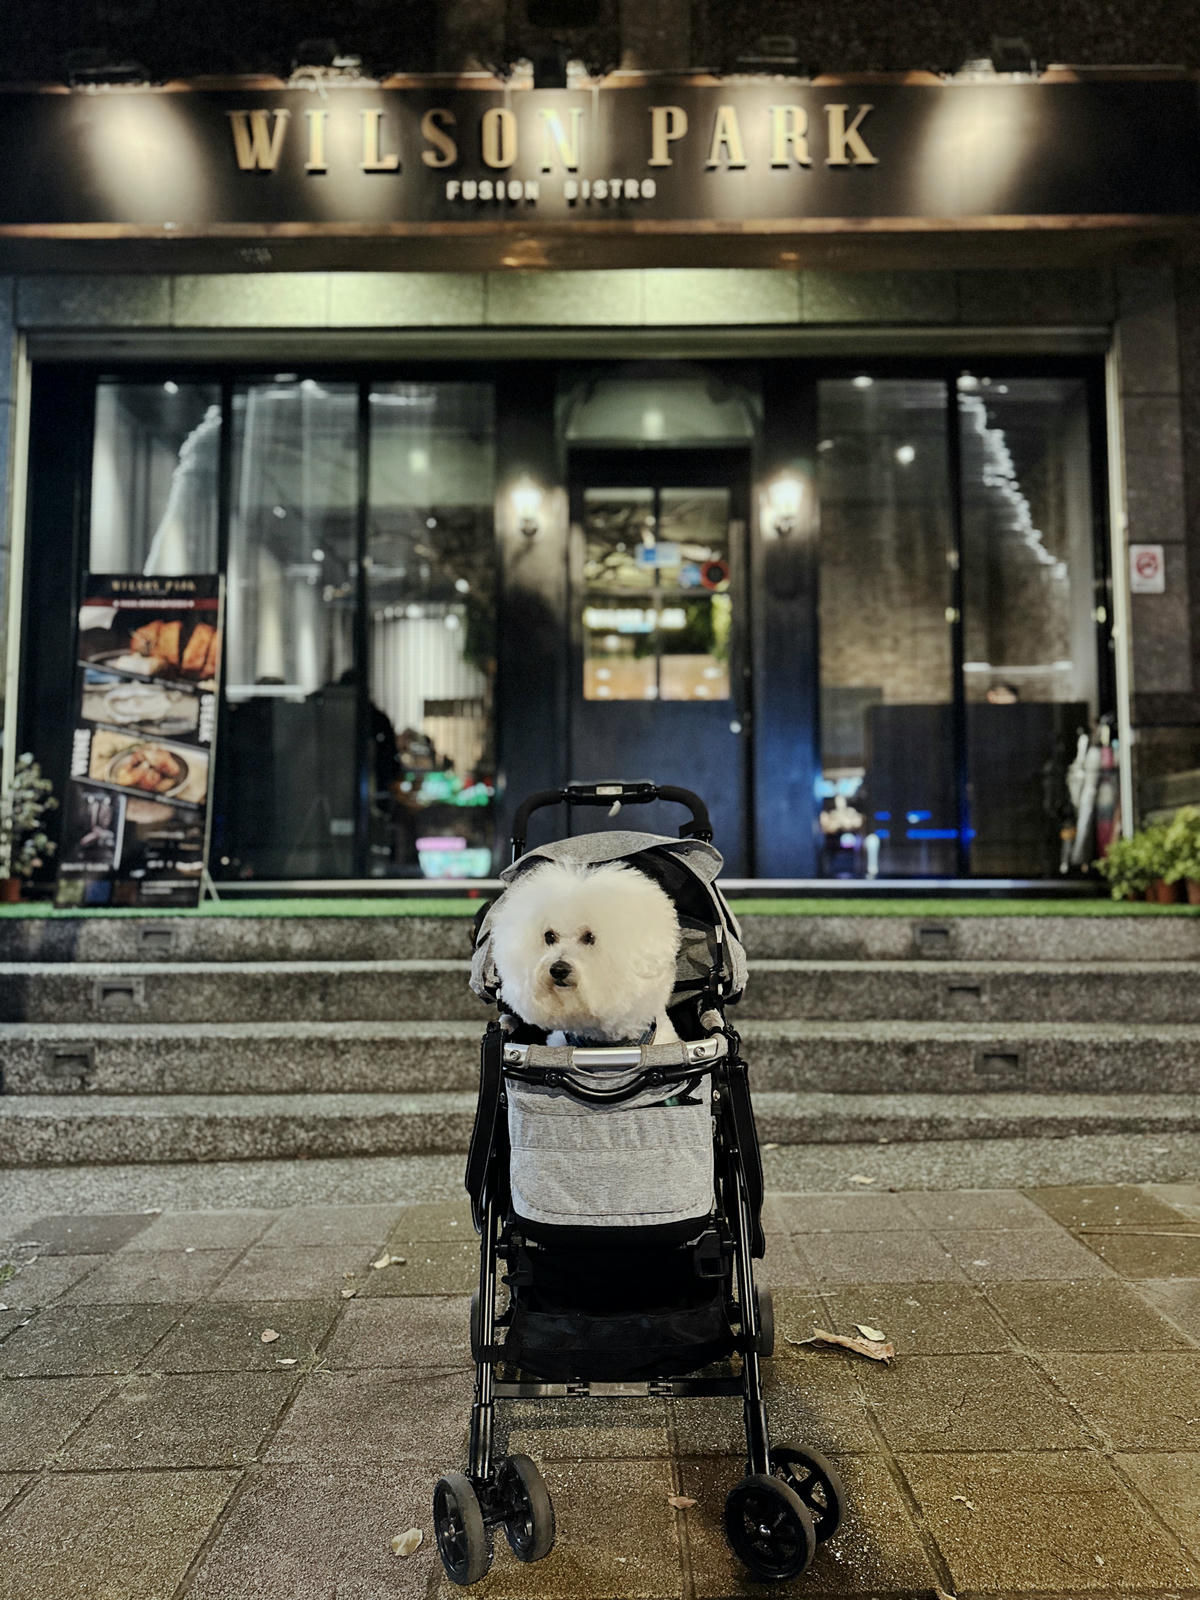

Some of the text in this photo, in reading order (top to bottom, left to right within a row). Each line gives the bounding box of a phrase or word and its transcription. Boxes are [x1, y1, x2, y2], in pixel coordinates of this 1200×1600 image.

[227, 104, 879, 170] WILSON PARK
[446, 178, 657, 200] FUSION BISTRO
